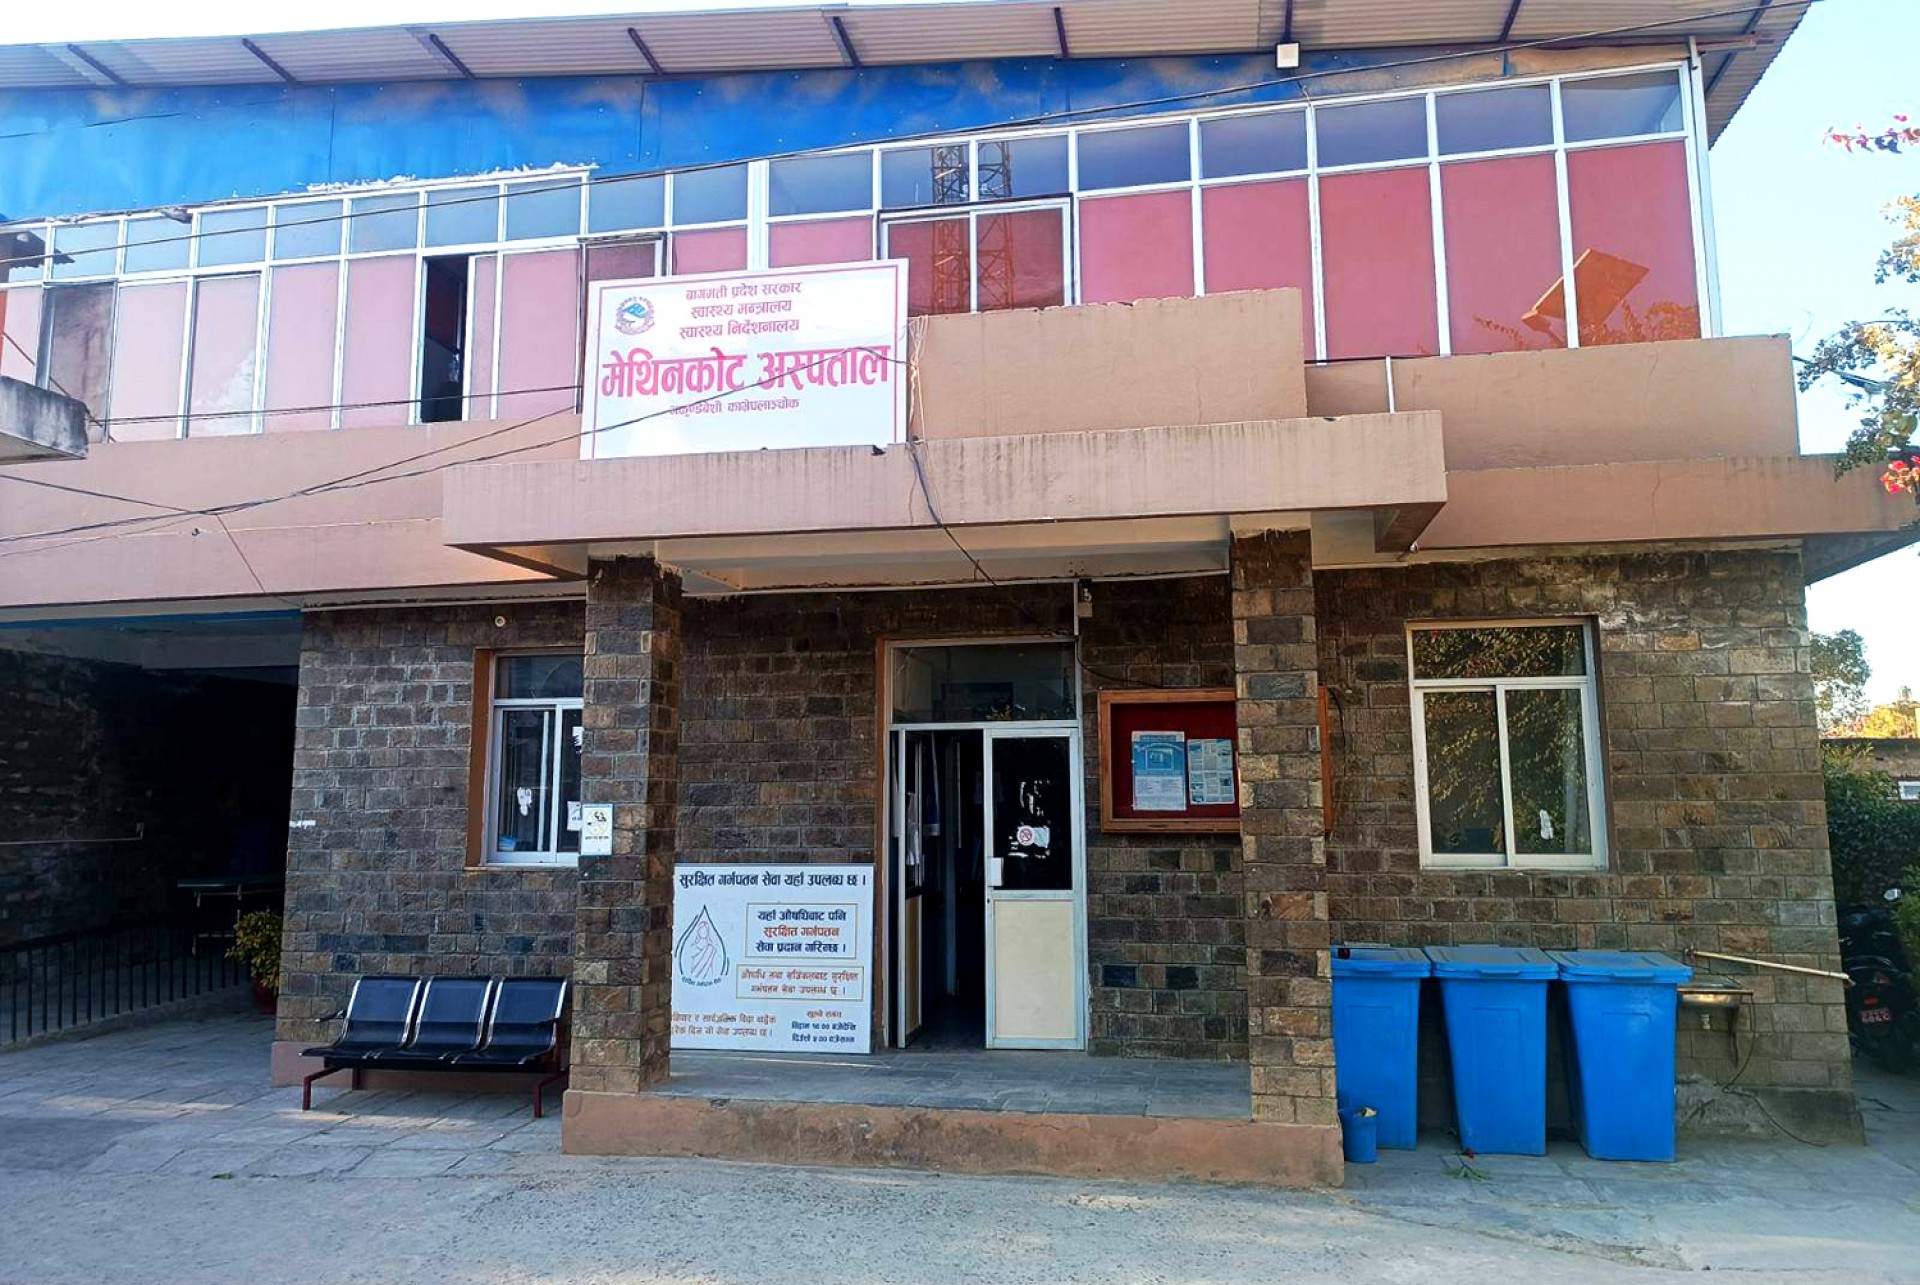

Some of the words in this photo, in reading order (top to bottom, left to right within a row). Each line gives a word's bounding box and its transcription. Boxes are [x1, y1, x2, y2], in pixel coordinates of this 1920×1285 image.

[686, 284, 728, 301] बागमती
[731, 282, 758, 299] प्रदेश
[761, 281, 803, 296] सरकार
[691, 303, 734, 320] स्वास्थ्य
[737, 300, 792, 316] मन्त्रालय
[679, 322, 723, 340] स्वास्थ्य
[727, 317, 800, 337] निर्देशनालय
[601, 346, 747, 398] मेथिनकोट
[757, 345, 891, 391] अस्पताल
[679, 871, 715, 889] सुरक्षित
[718, 871, 759, 886] गर्भपतन
[762, 870, 781, 886] सेवा
[808, 873, 843, 886] उपलब्ध
[846, 873, 857, 886] छ
[828, 908, 847, 921] पनि
[763, 925, 798, 938] सुरक्षित
[800, 925, 840, 937] गर्भपतन
[755, 941, 774, 953] सेवा
[777, 942, 802, 953] प्रदान
